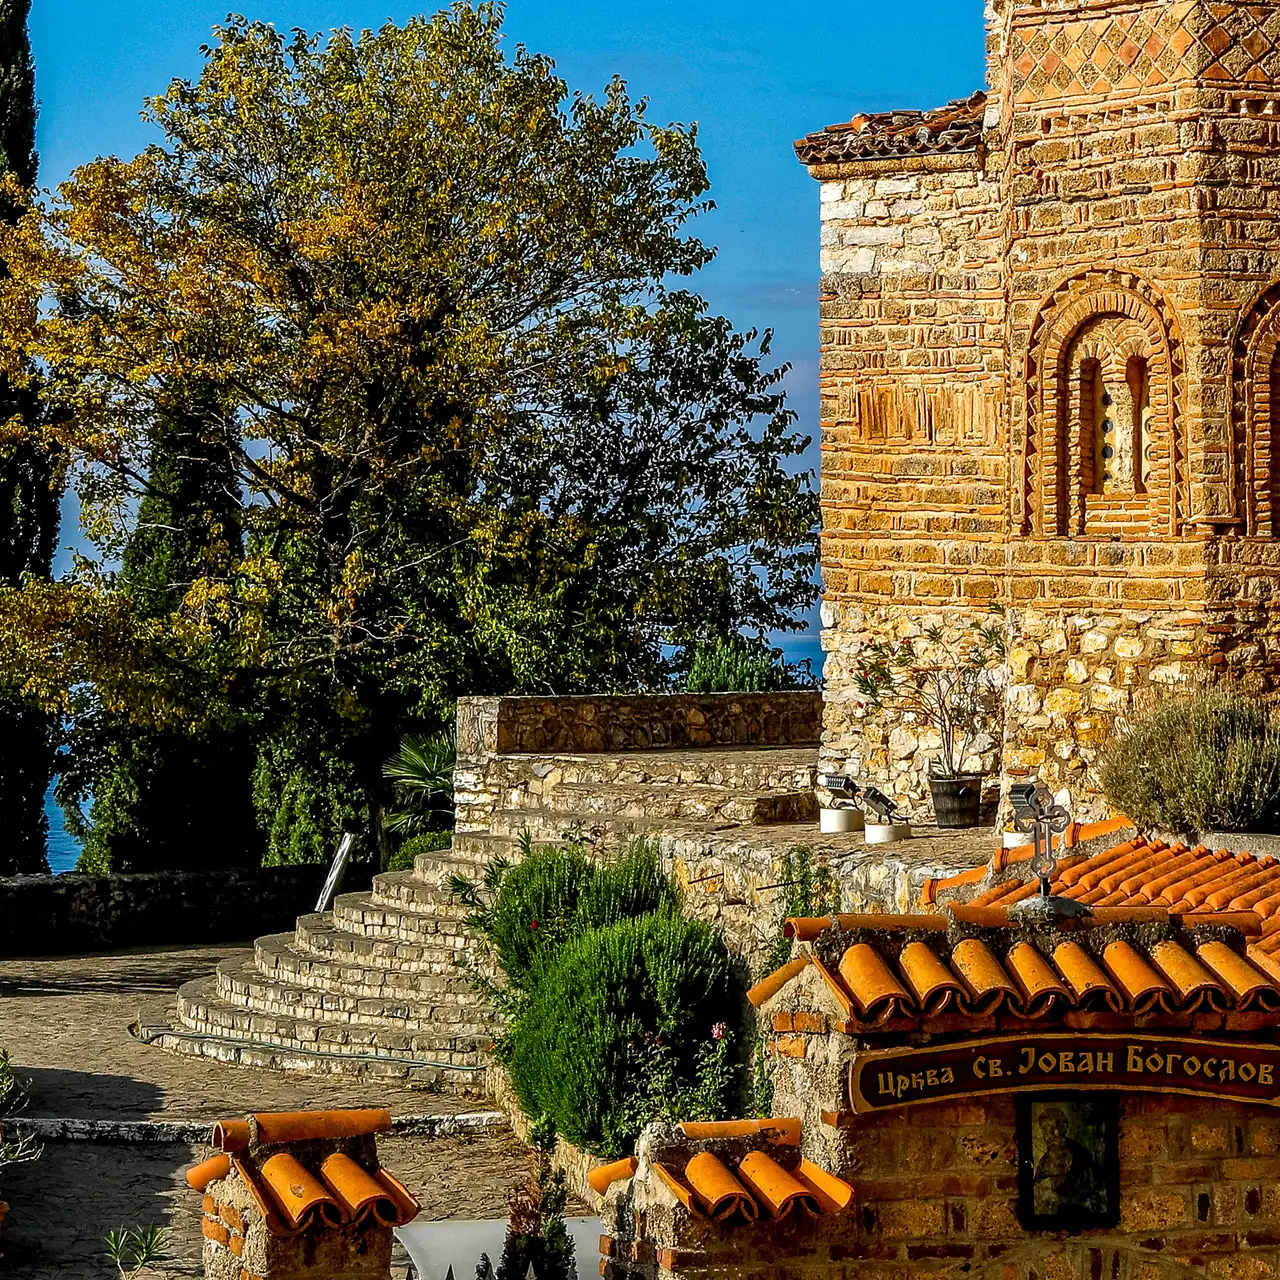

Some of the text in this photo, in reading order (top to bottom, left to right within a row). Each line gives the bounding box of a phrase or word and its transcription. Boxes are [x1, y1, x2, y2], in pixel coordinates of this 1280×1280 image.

[877, 1045, 1275, 1098] Црква Св. Јован Богослов
